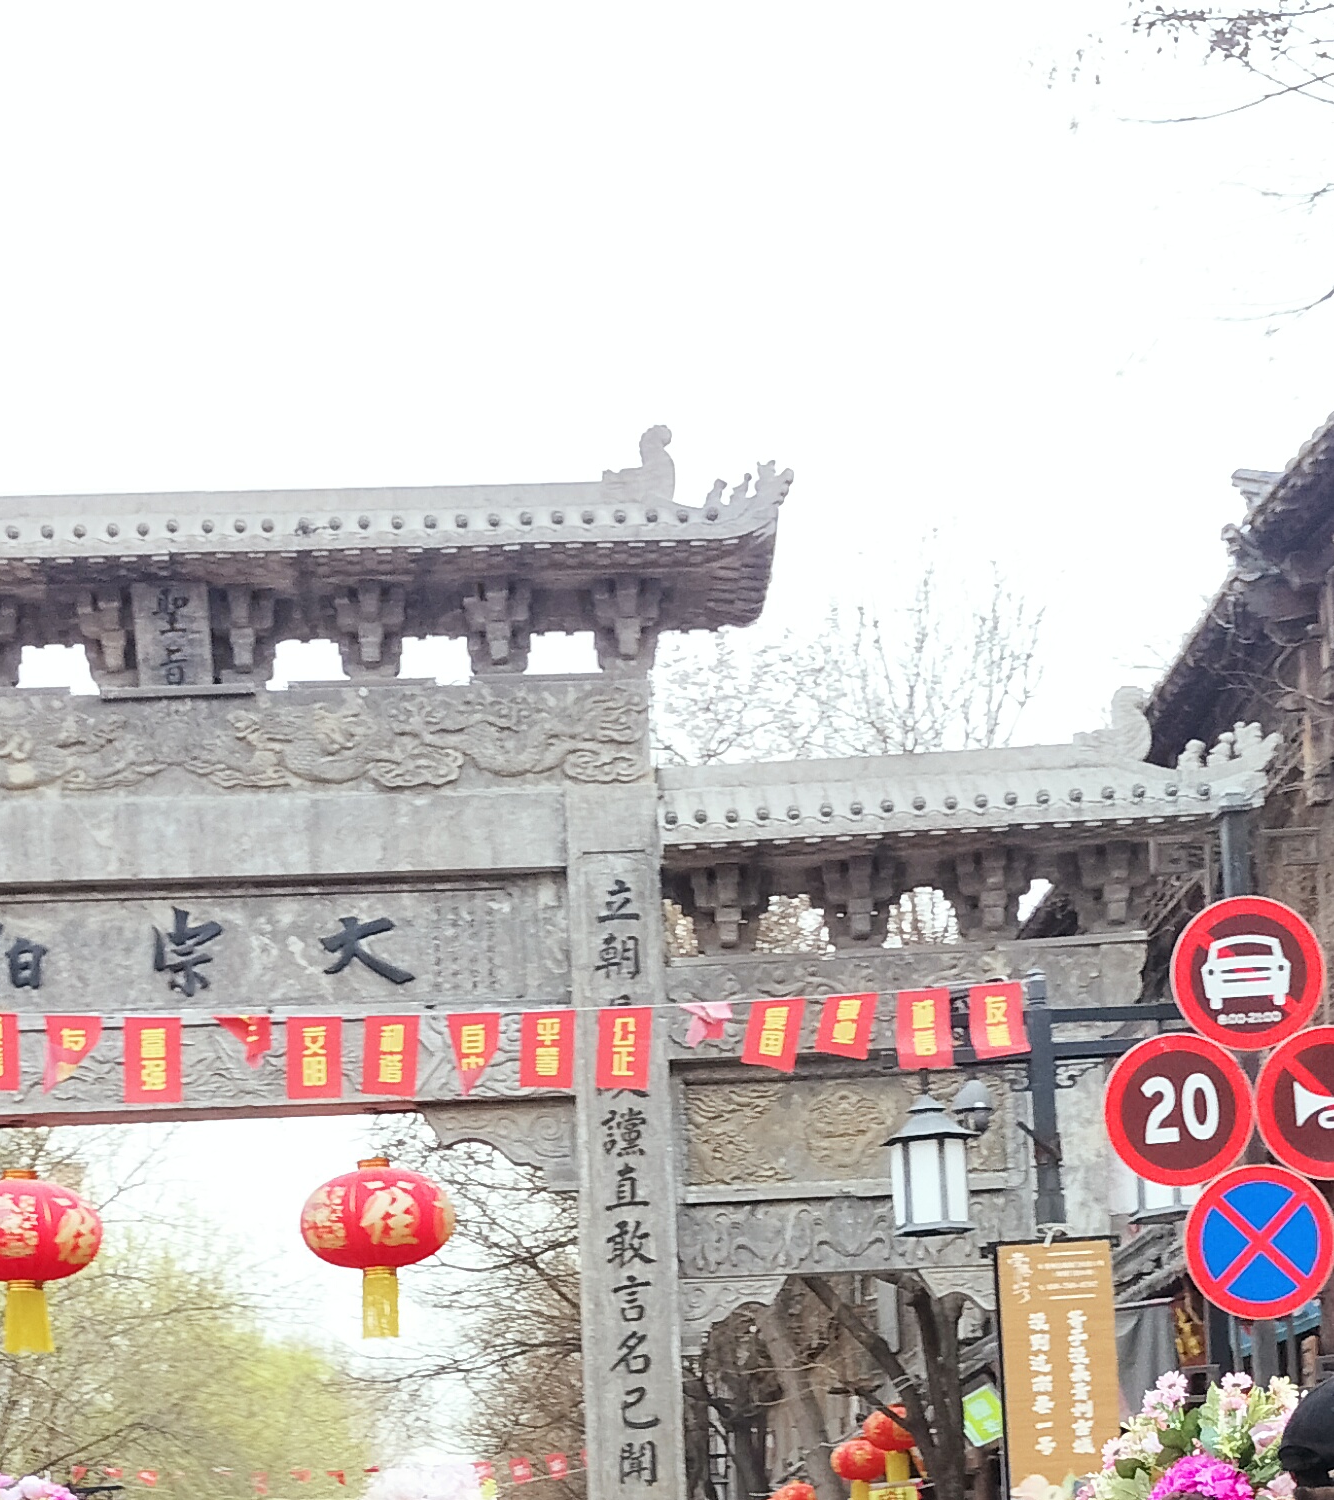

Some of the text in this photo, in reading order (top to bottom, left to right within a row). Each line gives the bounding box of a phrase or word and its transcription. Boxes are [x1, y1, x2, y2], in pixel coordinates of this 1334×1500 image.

[535, 1018, 561, 1076] 平等
[611, 1017, 636, 1076] 公正
[985, 995, 1011, 1047] 友善
[302, 1026, 327, 1087] 文明
[378, 1024, 405, 1083] 和谐
[1141, 1072, 1220, 1145] 20
